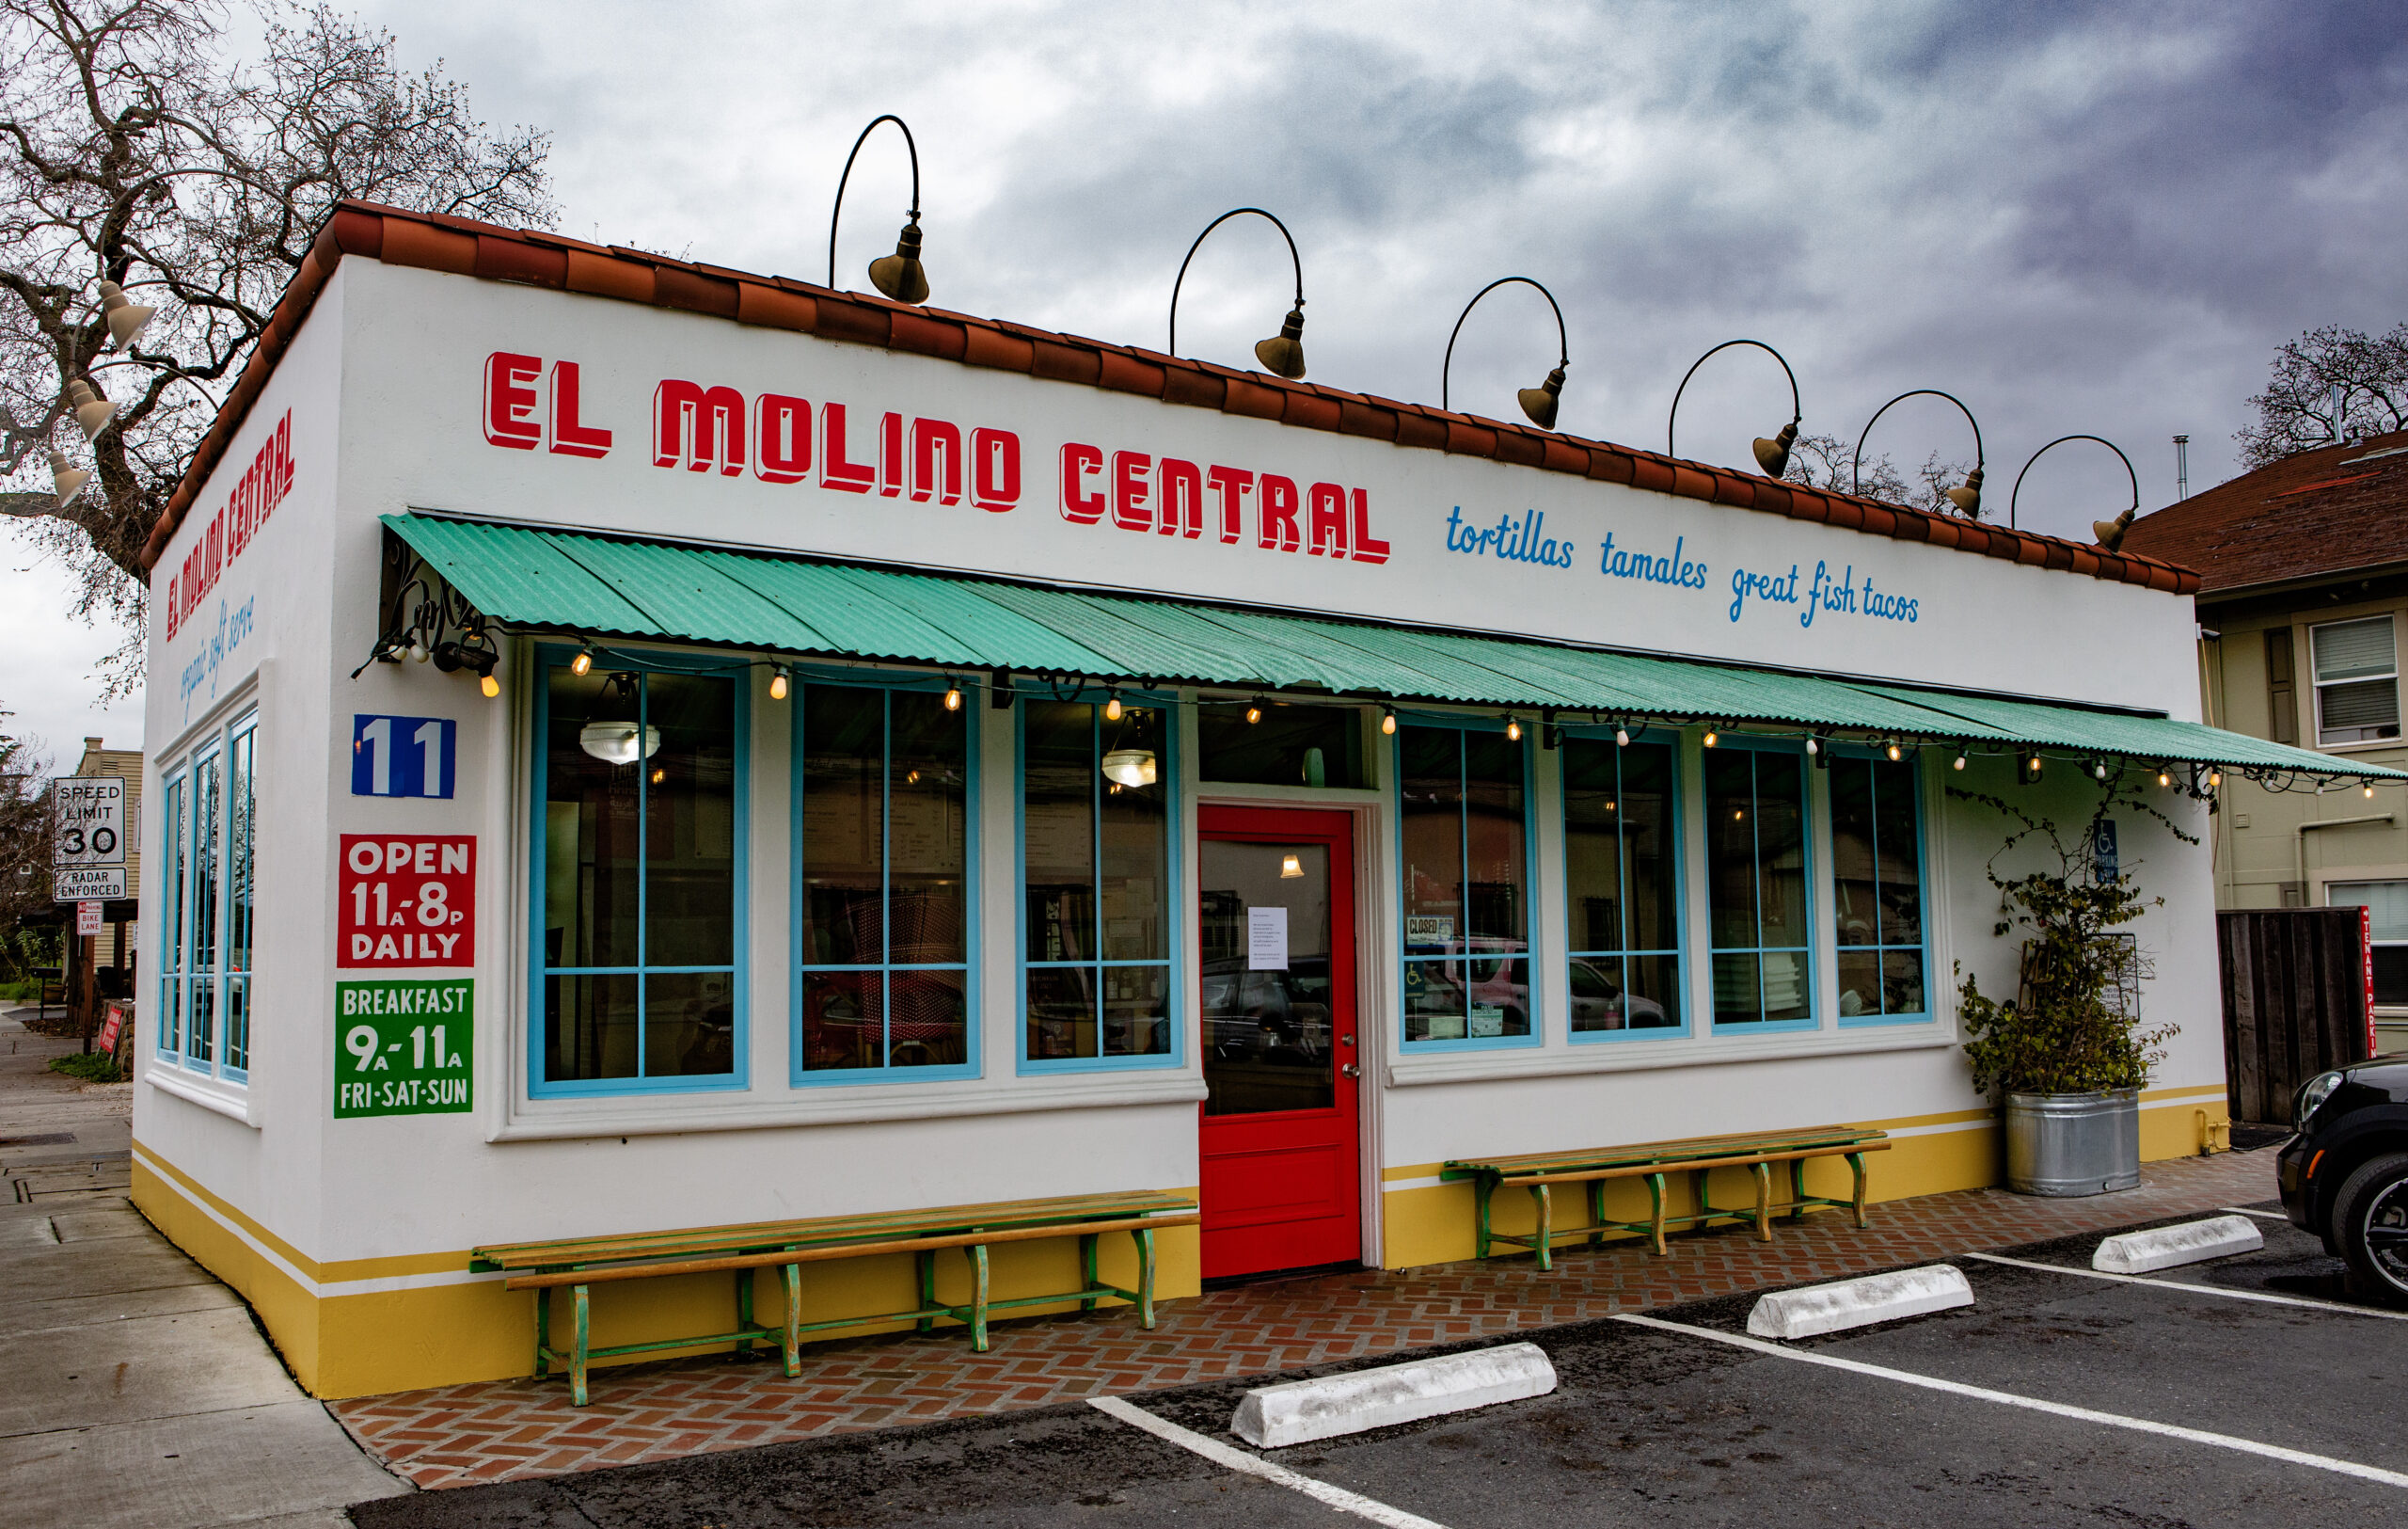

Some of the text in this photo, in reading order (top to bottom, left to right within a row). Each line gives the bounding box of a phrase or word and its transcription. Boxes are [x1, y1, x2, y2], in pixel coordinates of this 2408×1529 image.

[483, 351, 1390, 565] EL MOLINO CENTRAL
[167, 406, 295, 643] EL MOLINO CENTRAL
[1446, 505, 1919, 629] tortillas tamales great fish tacos
[181, 595, 255, 725] organic soft serve
[363, 718, 442, 796] 11
[60, 787, 120, 799] SPEED
[66, 807, 113, 820] LIMIT
[63, 827, 117, 854] 30
[348, 841, 468, 875] OPEN
[61, 884, 120, 897] ENFORCED
[71, 872, 109, 883] RADAR
[1409, 918, 1437, 934] CLOSED
[352, 933, 462, 960] DAILY
[343, 987, 467, 1015] BREAKFAST
[2364, 921, 2377, 1059] TENANT PARKIN
